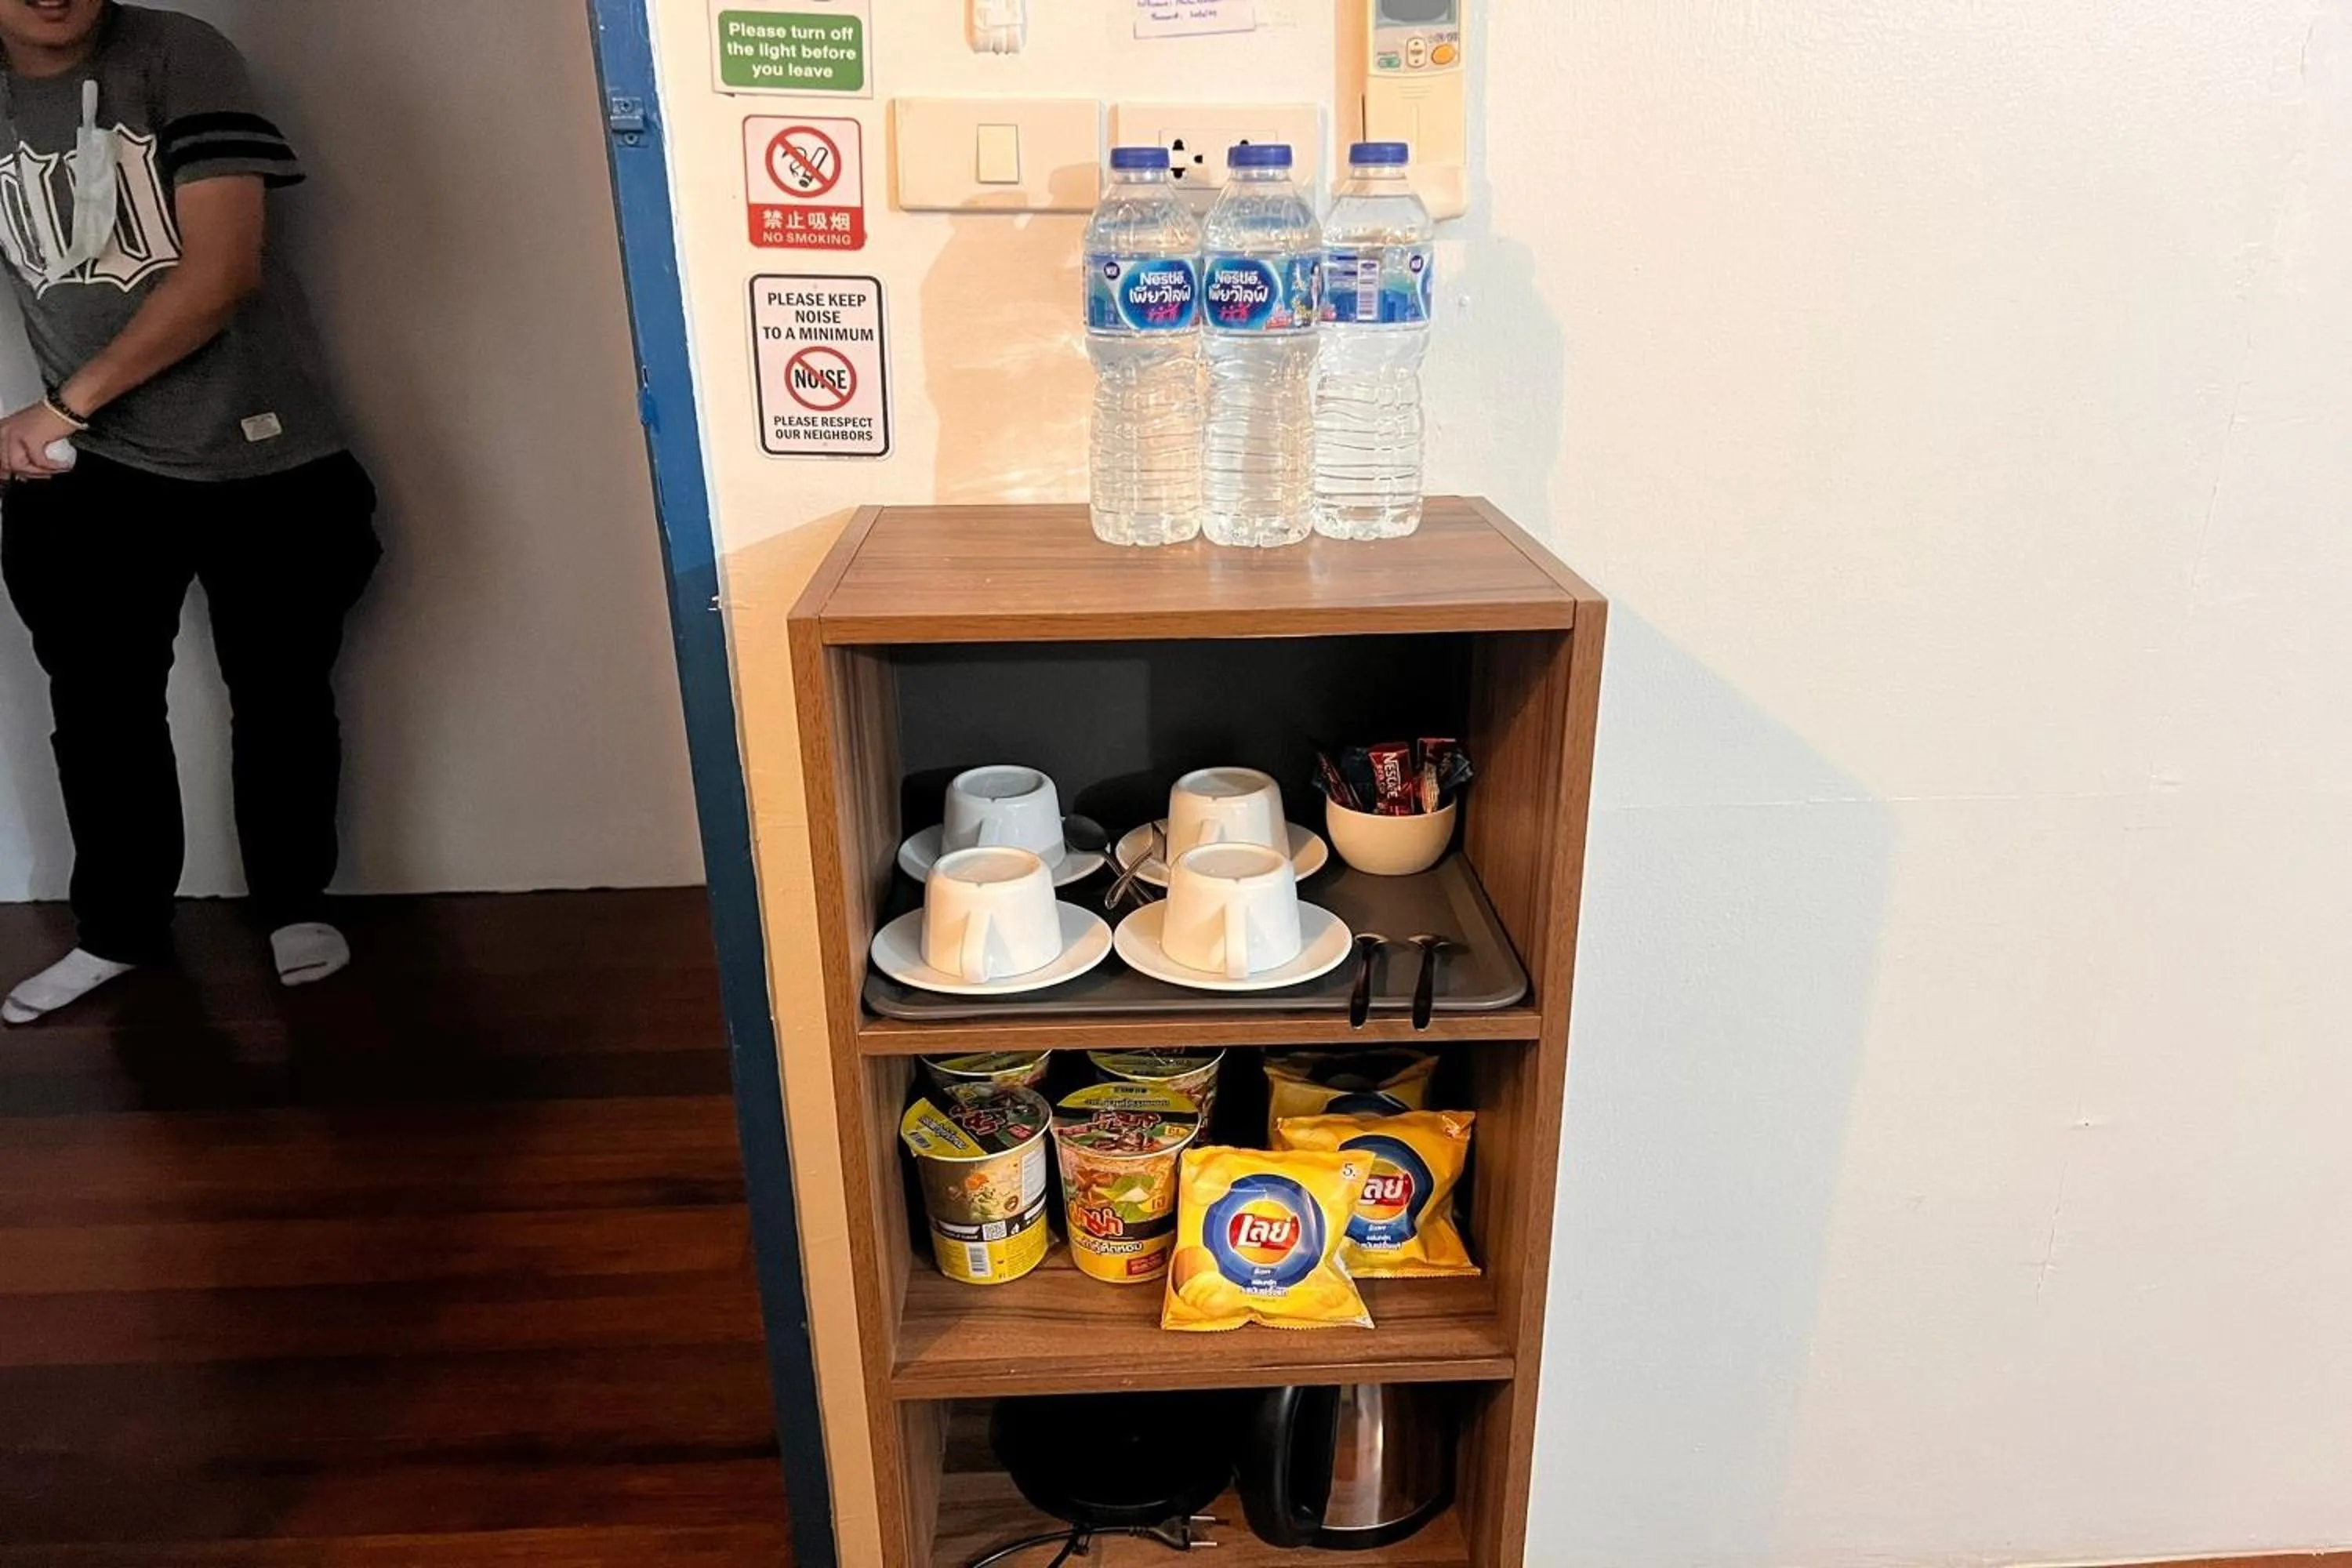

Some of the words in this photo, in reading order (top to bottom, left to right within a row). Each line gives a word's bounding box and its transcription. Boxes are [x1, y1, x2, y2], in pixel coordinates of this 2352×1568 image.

[728, 22, 786, 38] Please
[791, 25, 826, 40] turn
[830, 27, 854, 41] off
[727, 42, 754, 56] the
[760, 42, 796, 60] light
[801, 45, 856, 60] before
[752, 63, 783, 78] you
[789, 63, 833, 78] leave
[762, 209, 851, 231] 禁止吸烟
[762, 232, 783, 243] NO
[786, 233, 851, 245] SMOKING
[768, 292, 825, 307] PLEASE
[828, 294, 866, 307] KEEP
[795, 310, 841, 324] NOISE
[763, 326, 782, 339] TO
[785, 327, 796, 339] A
[799, 328, 874, 341] MINIMUM
[794, 368, 848, 390] NOISE
[774, 416, 818, 427] PLEASE
[821, 416, 873, 428] RESPECT
[775, 429, 801, 440] OUR
[804, 430, 873, 441] NEIGHBORS
[1236, 1215, 1291, 1247] เลย์
